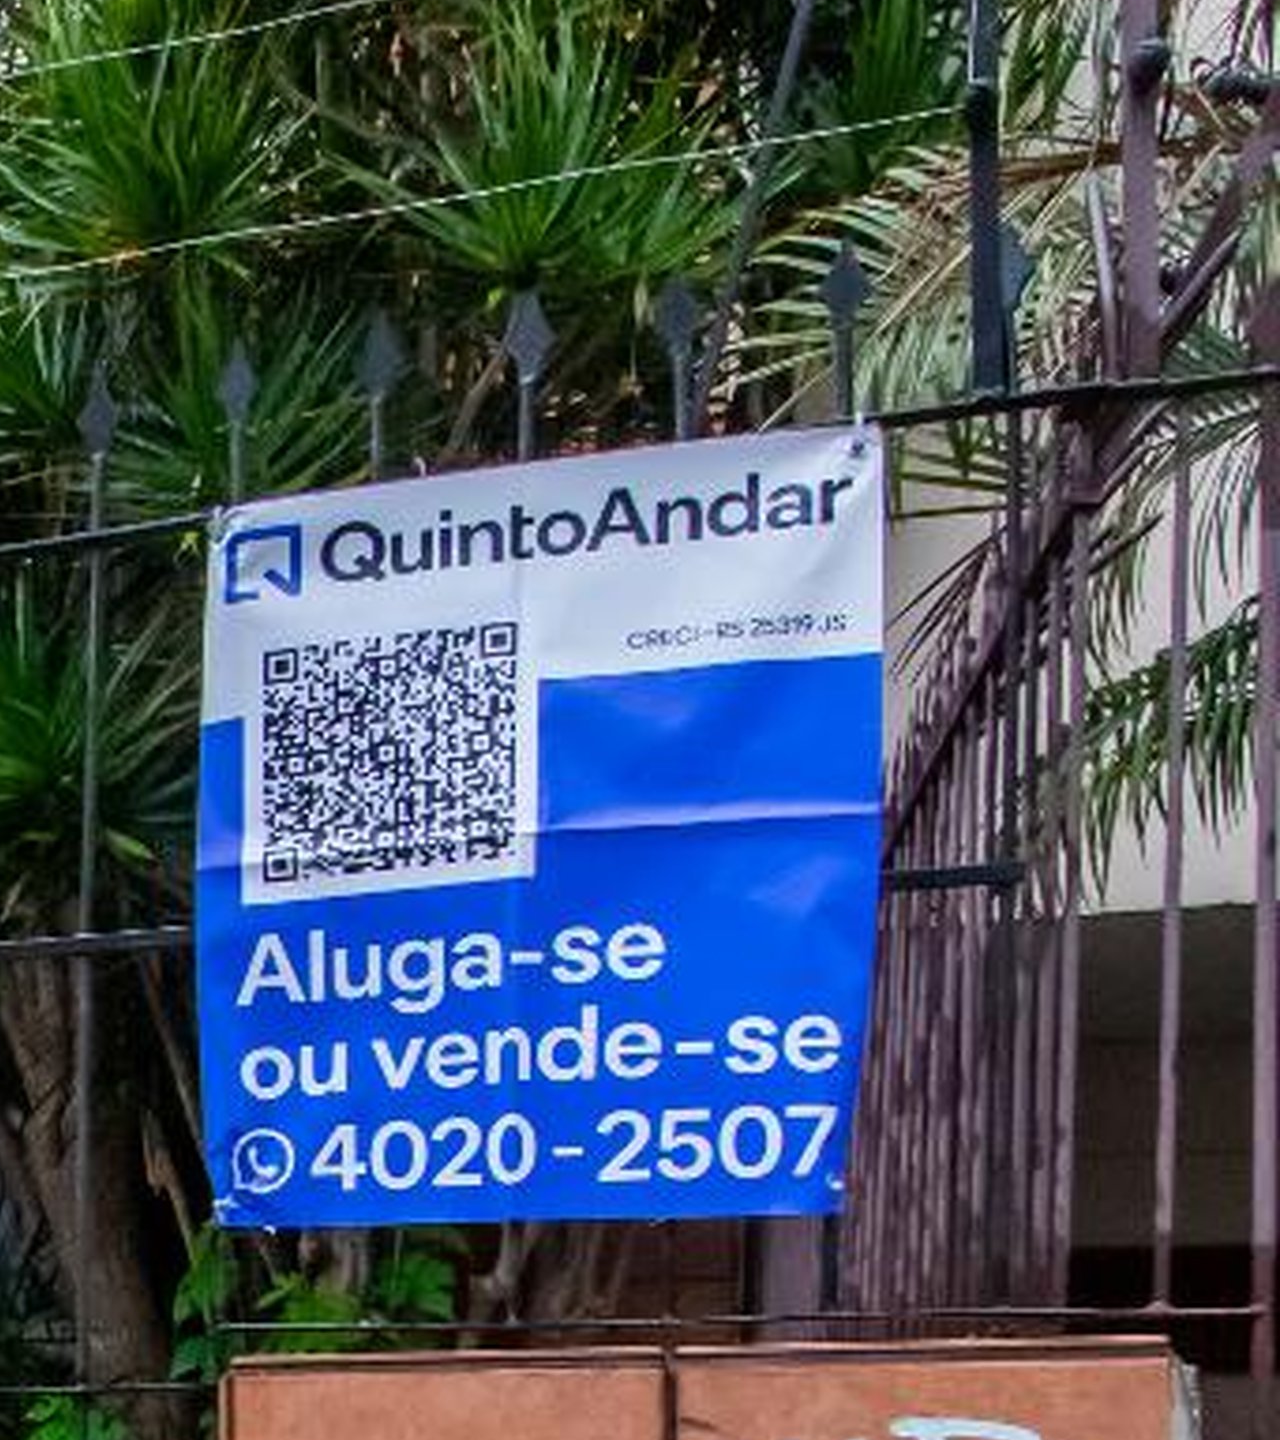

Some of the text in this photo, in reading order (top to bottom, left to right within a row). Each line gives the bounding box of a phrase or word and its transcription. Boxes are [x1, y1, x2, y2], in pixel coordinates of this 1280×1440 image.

[320, 473, 853, 582] QuintoAndar
[236, 921, 668, 1015] Aluga-se
[241, 1006, 842, 1102] ou vende-se
